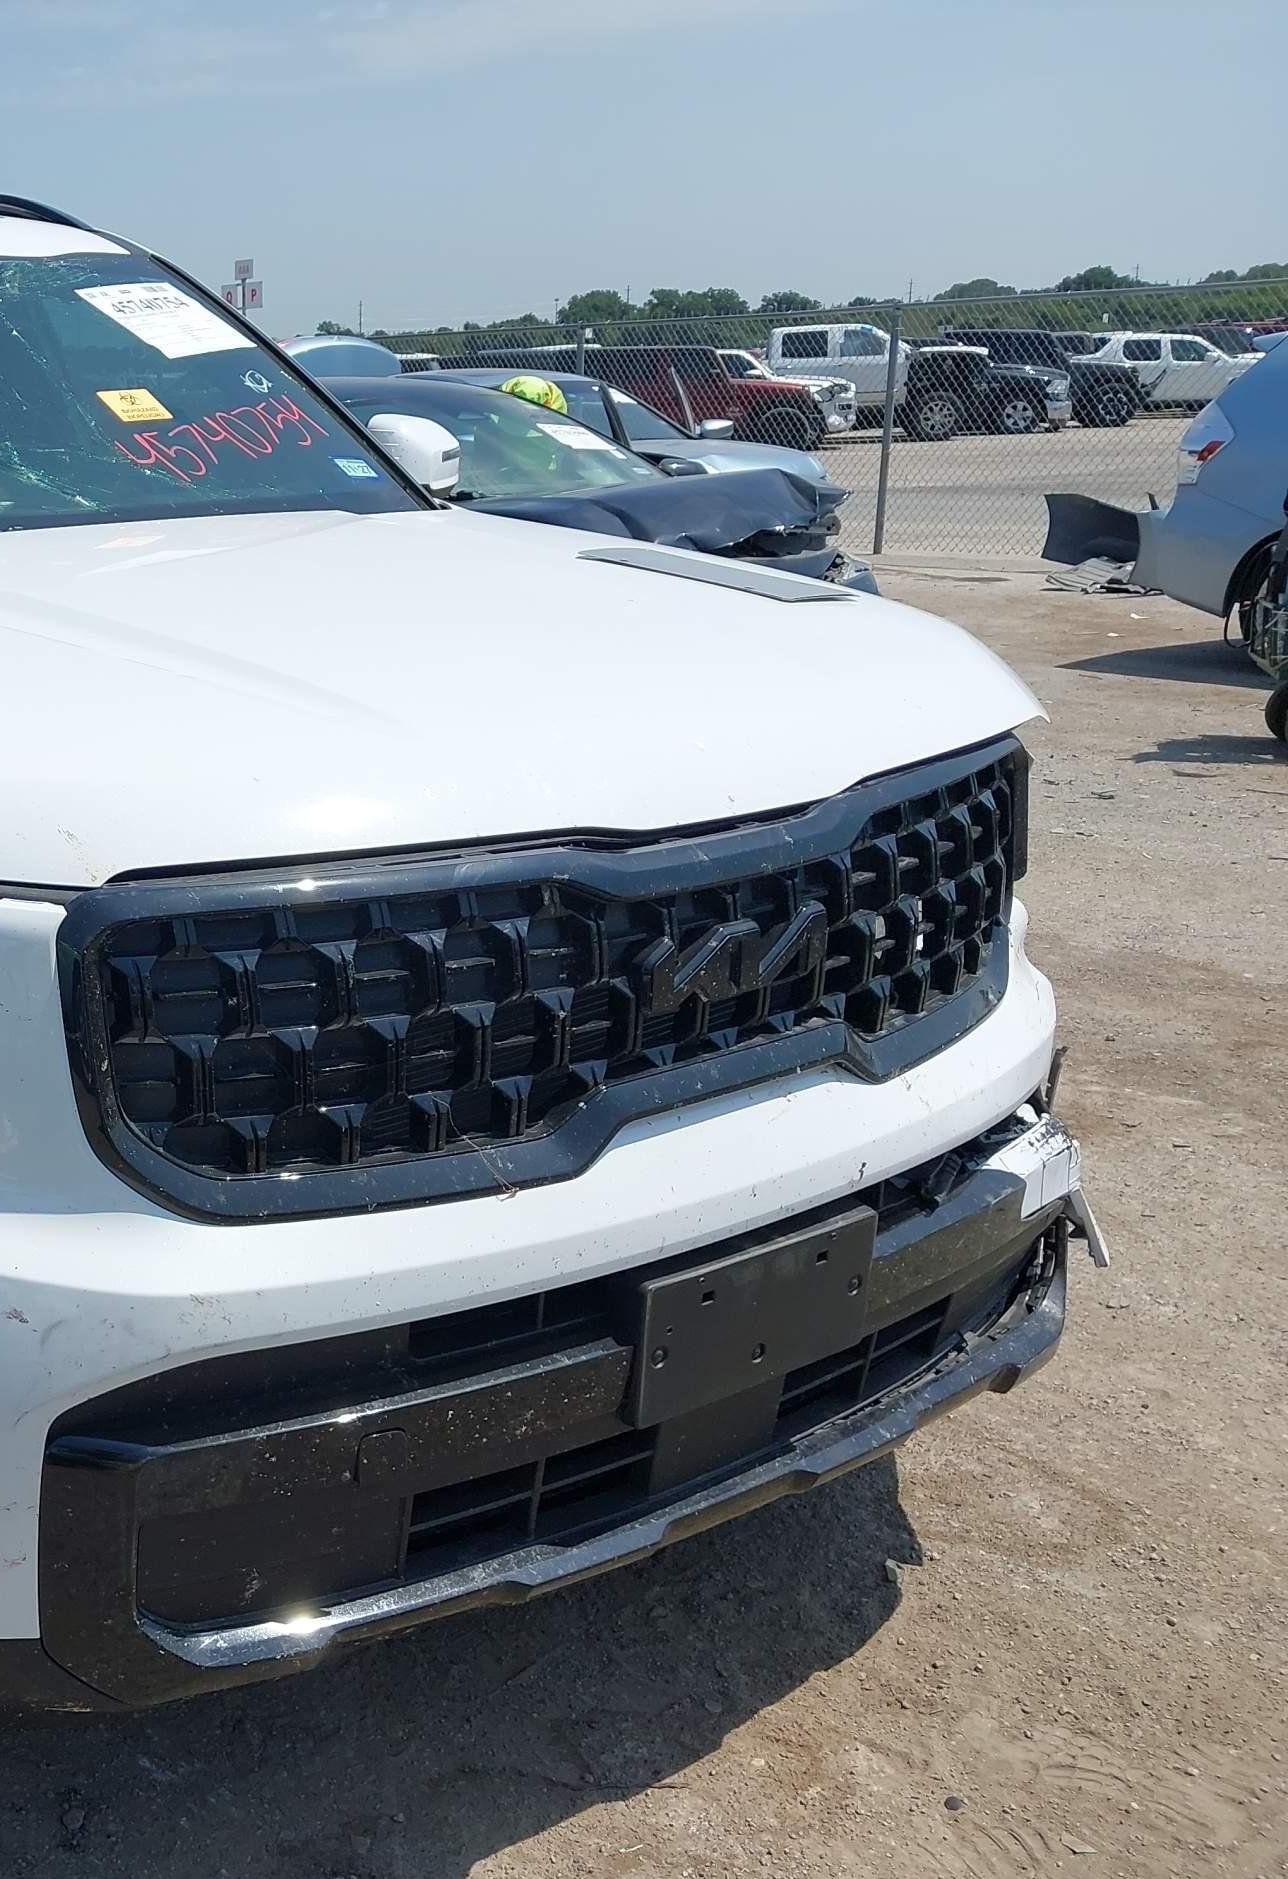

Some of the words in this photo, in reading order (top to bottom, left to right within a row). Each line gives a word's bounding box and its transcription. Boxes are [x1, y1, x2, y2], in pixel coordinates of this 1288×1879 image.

[251, 288, 257, 302] P
[111, 296, 190, 314] 45740754
[114, 394, 330, 482] 45740754
